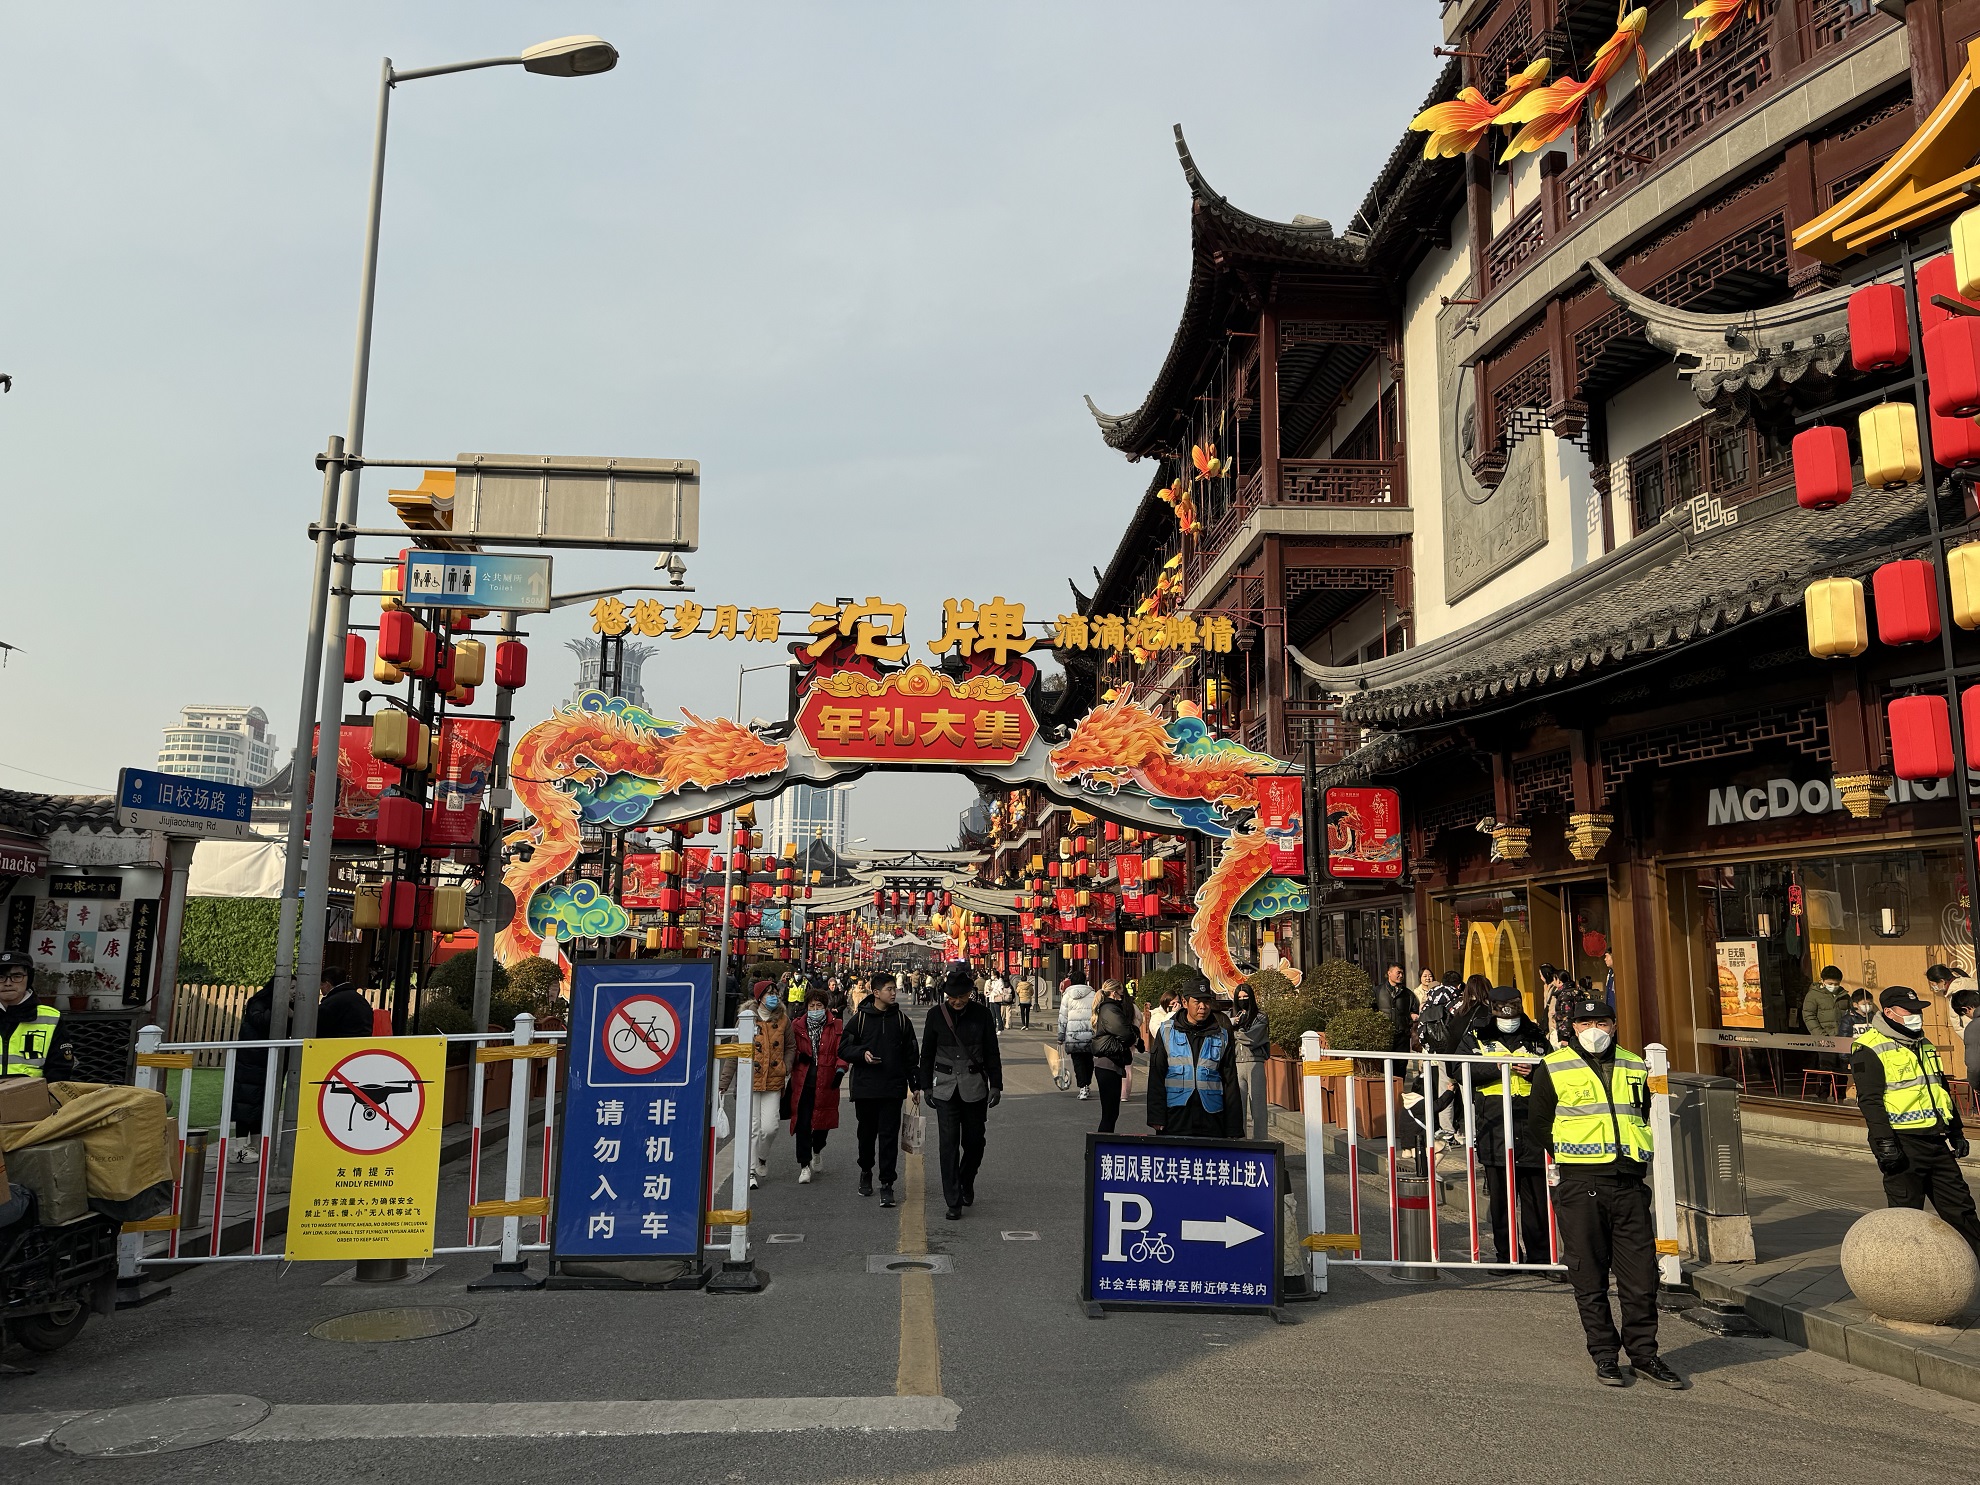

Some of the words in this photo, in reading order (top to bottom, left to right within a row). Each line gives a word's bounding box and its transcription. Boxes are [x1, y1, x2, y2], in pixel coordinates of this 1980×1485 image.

[481, 572, 523, 584] 公共厕所
[489, 584, 514, 592] Toilet
[520, 596, 544, 605] 150M
[589, 597, 781, 643] 悠悠岁月酒
[807, 596, 1037, 665] 沱牌
[1053, 613, 1236, 654] 滴滴沱牌情
[817, 705, 1023, 749] 年礼大集
[131, 793, 142, 804] 58
[157, 783, 226, 813] 旧校场路
[237, 792, 247, 806] 北
[130, 812, 138, 824] S
[236, 808, 245, 818] 58
[158, 815, 203, 831] Jiujiaochang
[206, 820, 218, 830] Rd.
[235, 824, 243, 836] N
[77, 904, 91, 926] 幸
[37, 937, 56, 956] 安
[103, 938, 121, 958] 康
[336, 1167, 395, 1178] 友情提示
[588, 1099, 625, 1240] 请勿入内
[640, 1098, 677, 1240] 非机动车
[1101, 1154, 1269, 1188] 豫园风景区共享单车禁止进入
[335, 1180, 362, 1188] KINDLY
[363, 1179, 394, 1188] REMIND
[1101, 1192, 1153, 1262] P
[1099, 1277, 1267, 1296] 社会车辆请停至附近停车线内
